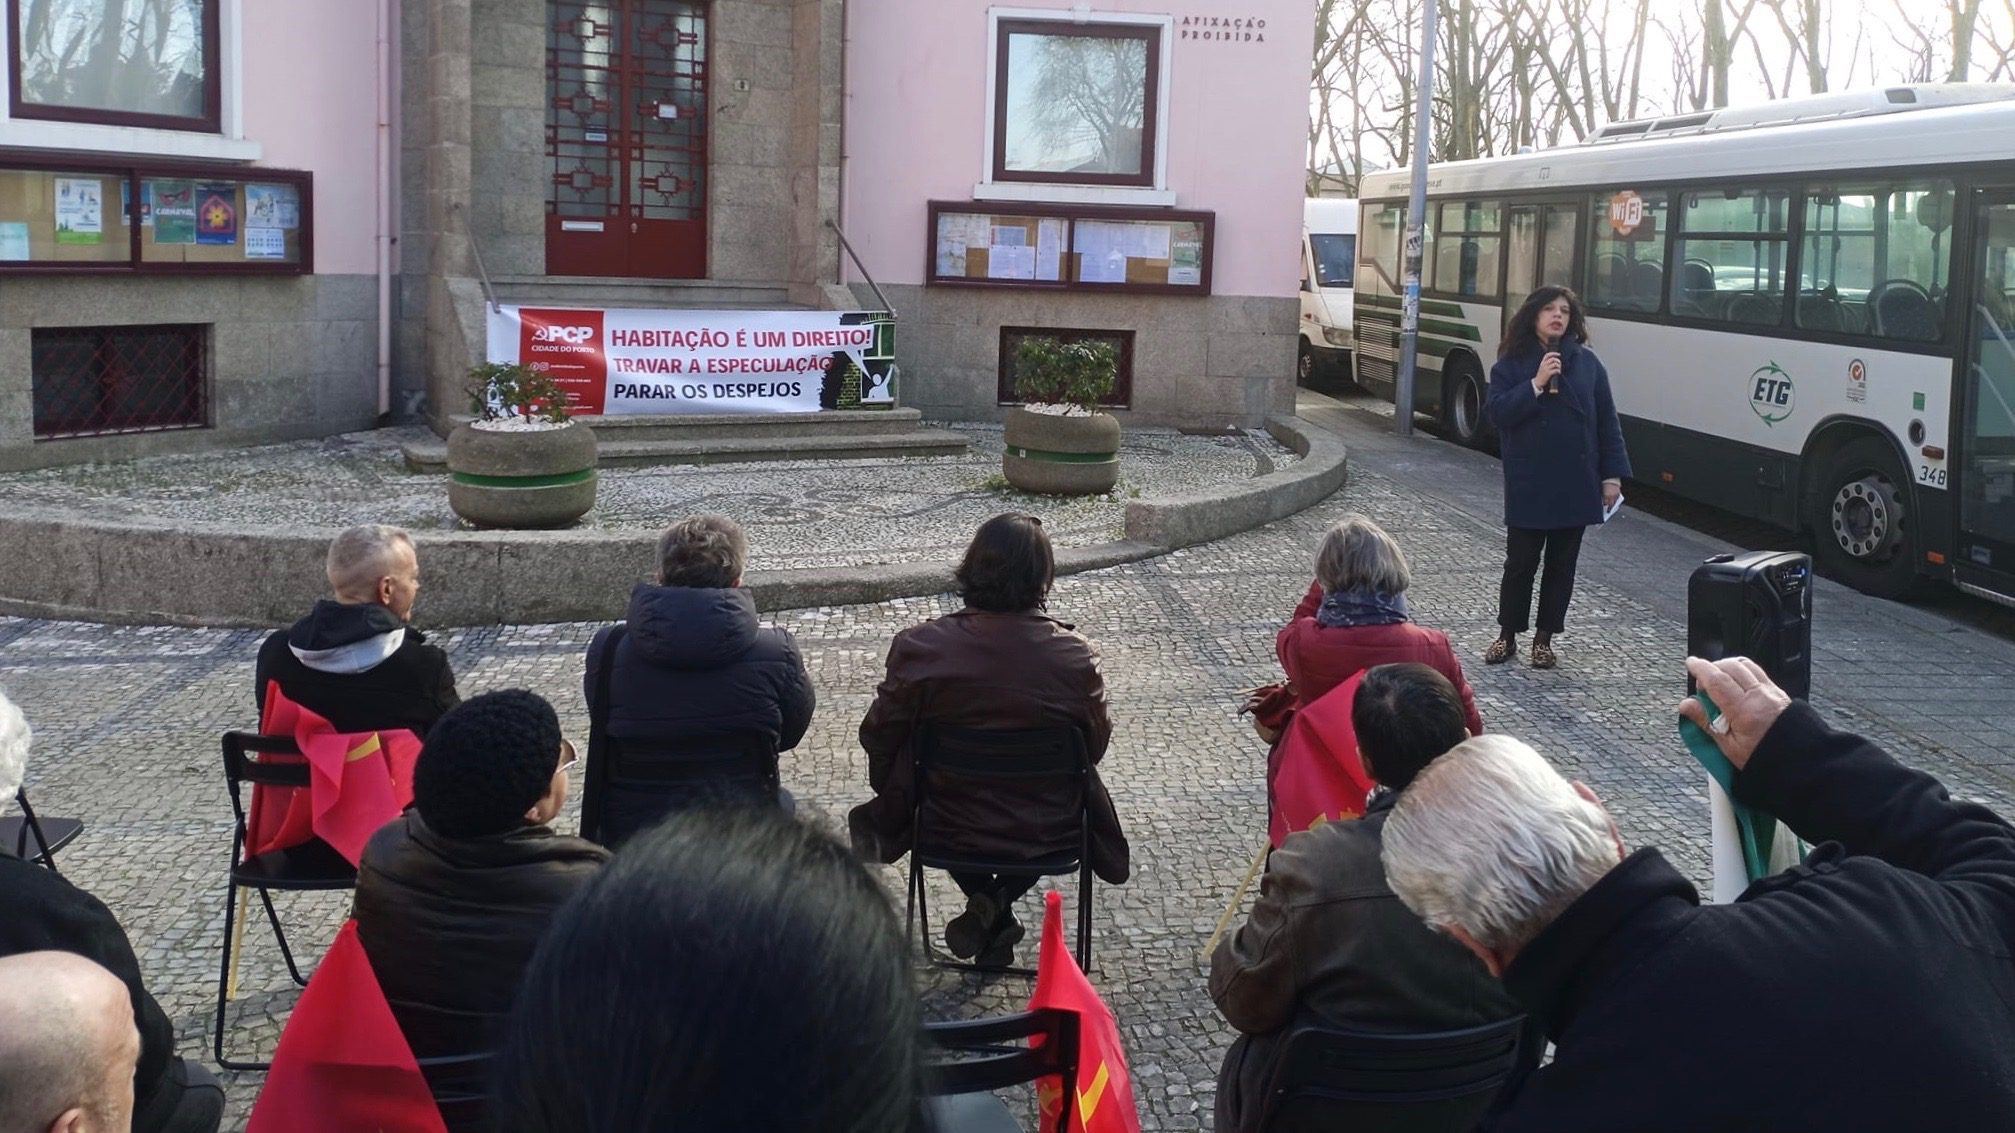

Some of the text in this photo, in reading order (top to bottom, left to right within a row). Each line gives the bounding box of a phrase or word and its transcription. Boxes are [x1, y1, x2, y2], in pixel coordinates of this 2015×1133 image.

[1182, 16, 1266, 30] AFIXAÇÃO
[1181, 30, 1265, 42] PROIBIDA
[1612, 201, 1640, 221] WiFi
[548, 326, 594, 344] PCP
[611, 327, 871, 351] HABITAÇÃO É UM DIREITO!
[613, 354, 834, 374] TRAVAR A ESPECULAÇÃO
[614, 382, 801, 399] PARAR OS DESPEJOS
[1754, 378, 1791, 405] ETG
[1919, 465, 1946, 485] 348
